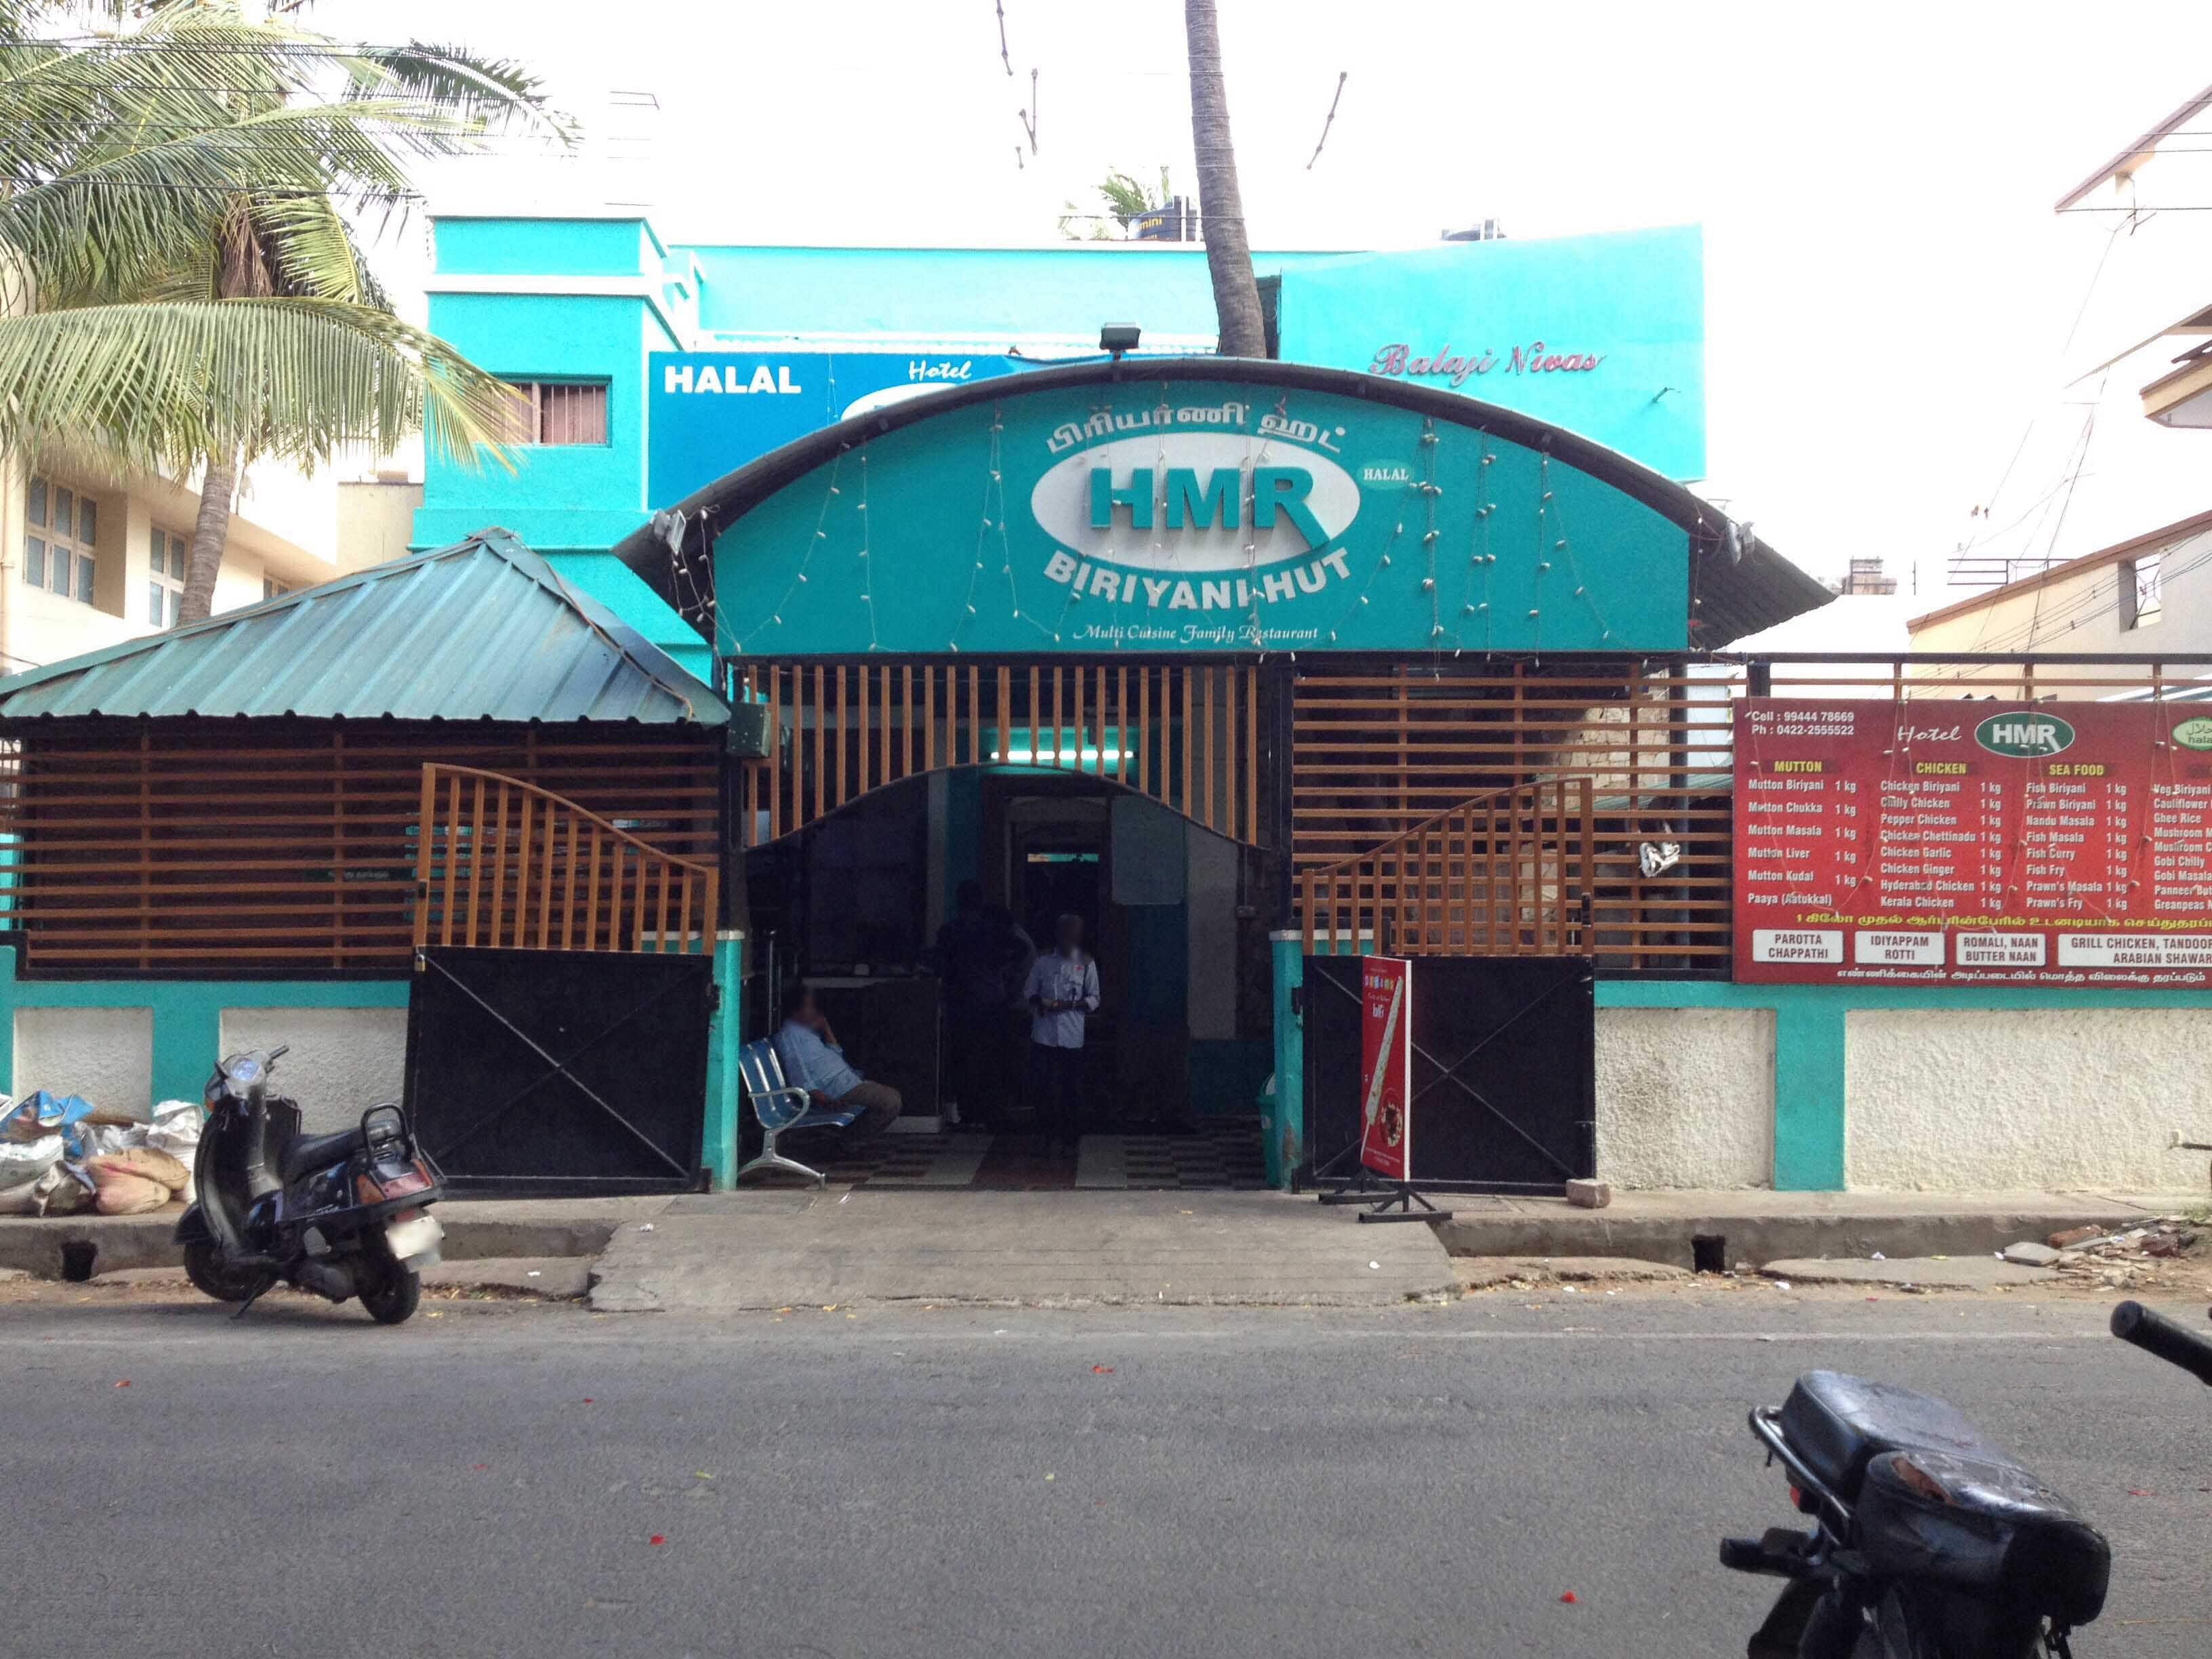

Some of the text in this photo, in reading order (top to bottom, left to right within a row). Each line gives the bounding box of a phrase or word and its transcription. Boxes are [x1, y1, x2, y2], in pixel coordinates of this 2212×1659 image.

[1370, 342, 1606, 386] Balaji Nivas
[909, 361, 972, 381] Hotel
[664, 366, 801, 394] HALAL
[1364, 468, 1408, 480] HALAL
[1091, 468, 1330, 548] HMR
[1043, 547, 1351, 609] BIRIYANI HUT
[1073, 625, 1123, 639] Multi
[1128, 625, 1176, 639] Cuisine
[1180, 625, 1235, 643] Family
[1752, 711, 1774, 721] Cell
[1784, 712, 1817, 721] 99444
[1821, 712, 1854, 722] 78669
[1752, 724, 1766, 734] Ph
[1777, 725, 1854, 735] 0422-2555522
[1898, 724, 2061, 752] Hotel HMR
[1774, 761, 1822, 772] MUTTON
[1917, 762, 1966, 774] CHICKEN
[2049, 764, 2104, 775] SEA FOOD
[1748, 779, 1856, 792] Mutton Biriyani 1 kg
[1881, 781, 2001, 794] Chicken Biriyani 1 kg
[2026, 782, 2127, 795] Fish Biriyani 1 kg
[2154, 783, 2211, 796] Veg Biriyani
[1748, 802, 1856, 816] Mutton Chukka 1 kg
[1911, 798, 1950, 808] Chicken
[1980, 800, 1985, 809] 1
[1990, 800, 2001, 810] kg
[2026, 799, 2127, 811] Prawn Biriyani 1 kg
[2154, 798, 2207, 808] Cauliflower
[1881, 814, 2001, 827] Pepper Chicken 1 kg
[2026, 815, 2127, 828] Nandu Masala 1 kg
[2154, 813, 2201, 823] Ghee Rice
[1748, 825, 1856, 840] Mutton Masala 1 kg
[1881, 830, 2001, 843] Chicken Chettinadu 1 kg
[2026, 832, 2127, 844] Fish Masala 1 kg
[2154, 827, 2202, 838] Mushroom
[1881, 846, 2001, 860] Chicken Garlic 1 kg
[2154, 842, 2202, 852] Mushroom
[1748, 847, 1856, 863] Mutton Liver 1 kg
[2026, 848, 2127, 861] Fish Curry 1 kg
[2154, 857, 2205, 868] Gobi Chilly
[1881, 863, 2001, 877] Chicken Ginger 1 kg
[2026, 865, 2127, 878] Fish Fry 1 kg
[2154, 870, 2212, 881] Gobi Masala
[1748, 870, 1856, 887] Mutton Kudal 1 kg
[1936, 881, 1974, 891] Chicken
[1980, 882, 1985, 891] 1
[1990, 882, 2001, 893] kg
[2026, 881, 2127, 893] Prawn's Masala 1 kg
[2154, 885, 2192, 895] Panneer
[1748, 893, 1832, 906] Paaya (Aatukkal)
[1881, 896, 2001, 909] Kerala Chicken 1 kg
[2026, 897, 2127, 910] Prawn's Fry 1 kg
[2154, 899, 2205, 911] Greanpeas
[1775, 934, 1822, 944] PAROTTA
[1870, 935, 1929, 946] IDIYAPPAM
[1964, 937, 2038, 948] ROMALI, NAAN
[2071, 937, 2103, 948] GRILL
[2107, 938, 2159, 950] CHICKEN,
[1769, 947, 1828, 958] CHAPPATHI
[1885, 949, 1914, 960] ROTTI
[1966, 951, 2036, 962] BUTTER NAAN
[2113, 953, 2212, 964] ARABIAN SHAWAR
